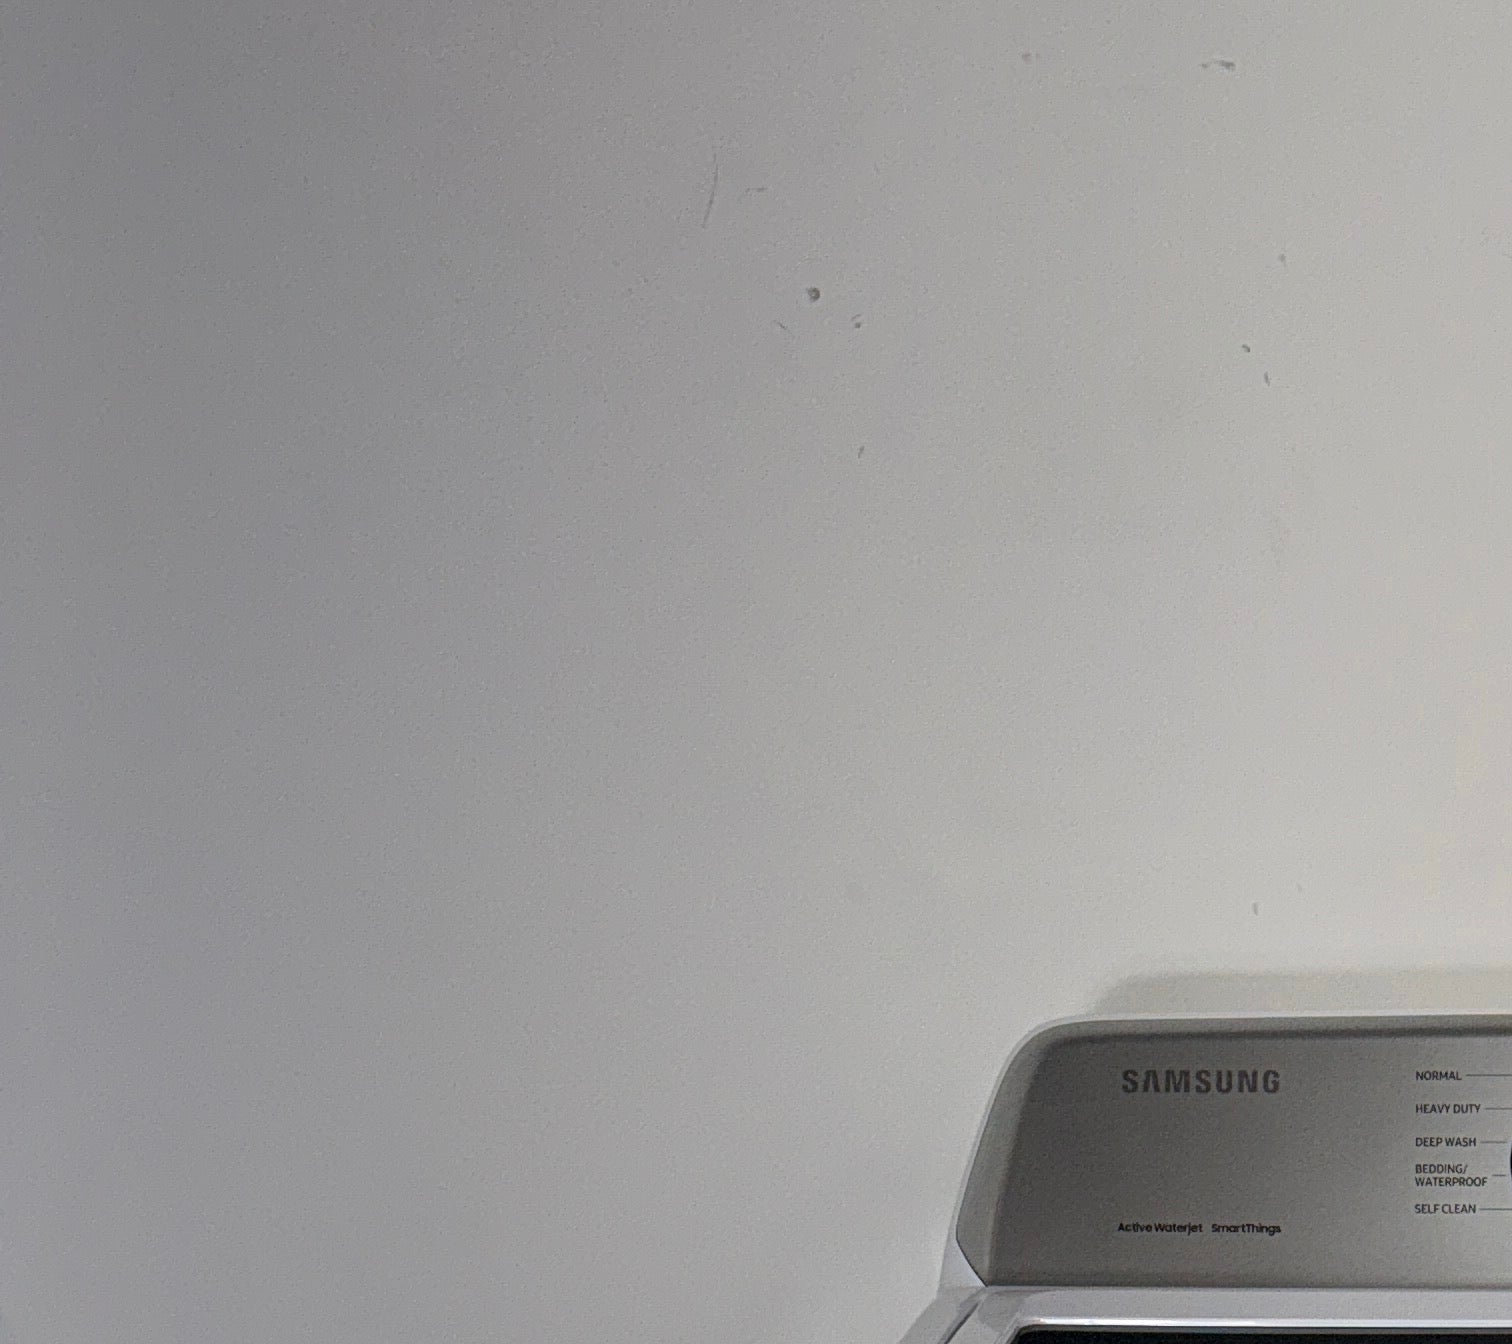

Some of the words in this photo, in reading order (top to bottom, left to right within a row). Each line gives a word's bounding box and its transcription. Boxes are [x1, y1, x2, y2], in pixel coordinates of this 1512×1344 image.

[1122, 1069, 1281, 1094] SAMSUNG
[1415, 1071, 1462, 1081] NORMAL
[1415, 1104, 1450, 1114] HEAVY
[1453, 1104, 1481, 1114] DUTY
[1415, 1137, 1442, 1147] DEEP
[1444, 1137, 1477, 1147] WASH
[1415, 1164, 1469, 1175] BEDDING/
[1415, 1176, 1488, 1187] WATERPROOF
[1415, 1204, 1440, 1214] SELF
[1442, 1204, 1476, 1214] CLEAN
[1117, 1222, 1153, 1233] Active
[1211, 1222, 1282, 1235] SmartThings
